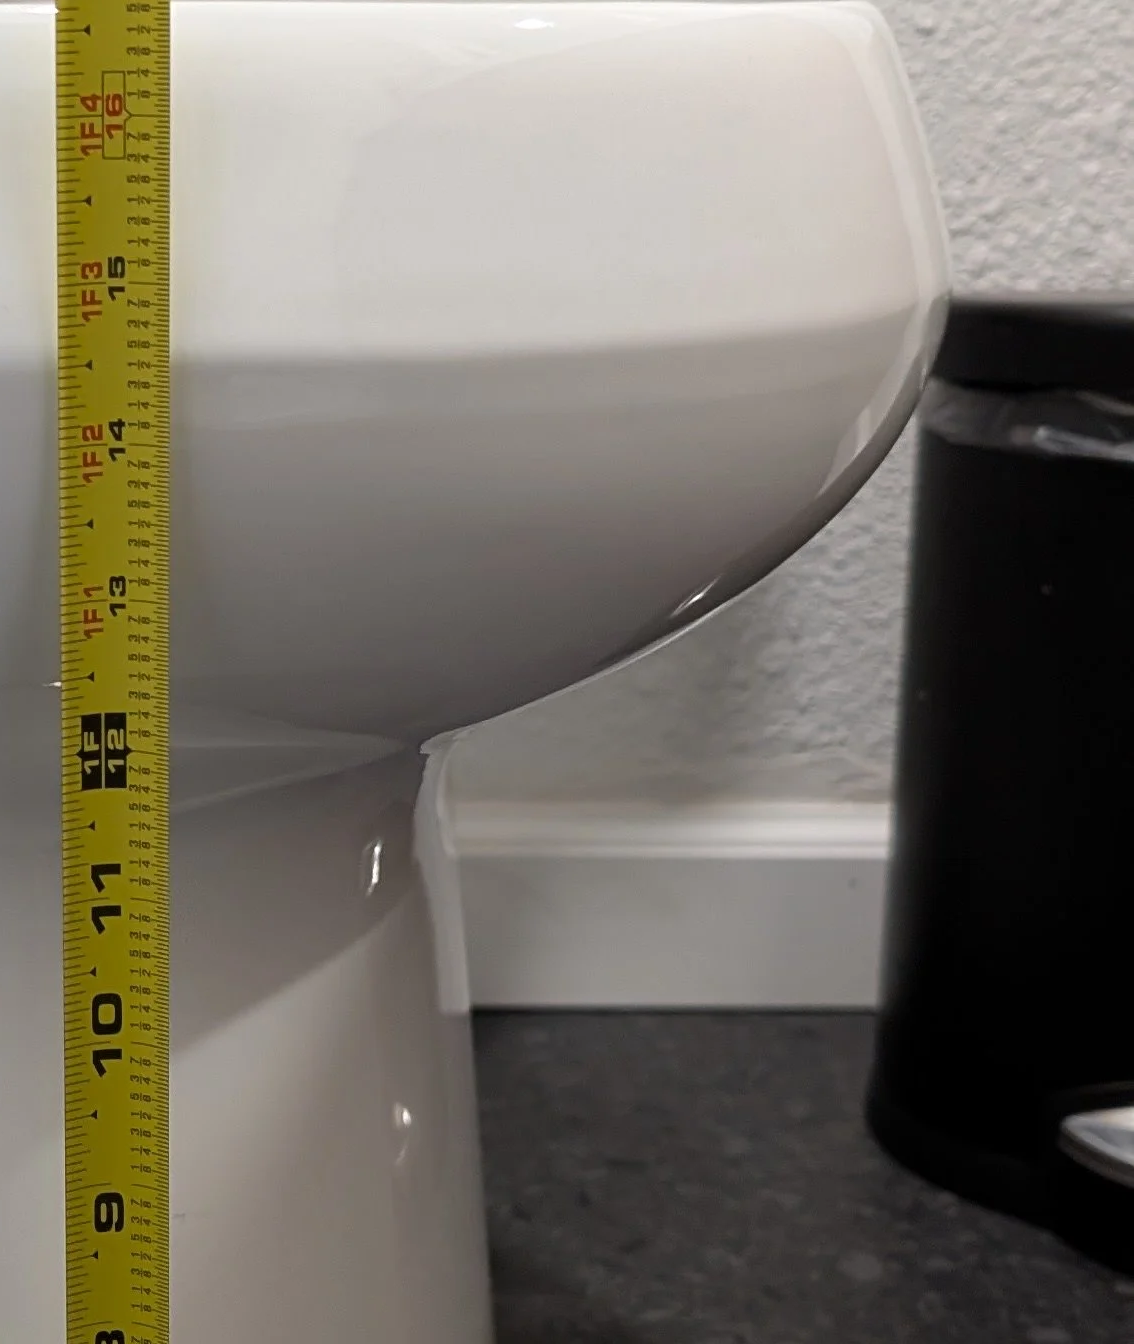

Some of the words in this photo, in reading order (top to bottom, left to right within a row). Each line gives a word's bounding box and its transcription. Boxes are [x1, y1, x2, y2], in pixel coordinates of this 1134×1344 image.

[105, 93, 124, 139] 16
[107, 256, 126, 302] 15
[108, 418, 126, 463] 14
[109, 575, 127, 617] 13
[82, 731, 101, 775] 1F
[107, 729, 125, 774] 12
[90, 863, 122, 935] 11
[91, 993, 123, 1078] 10
[93, 1192, 125, 1233] 9
